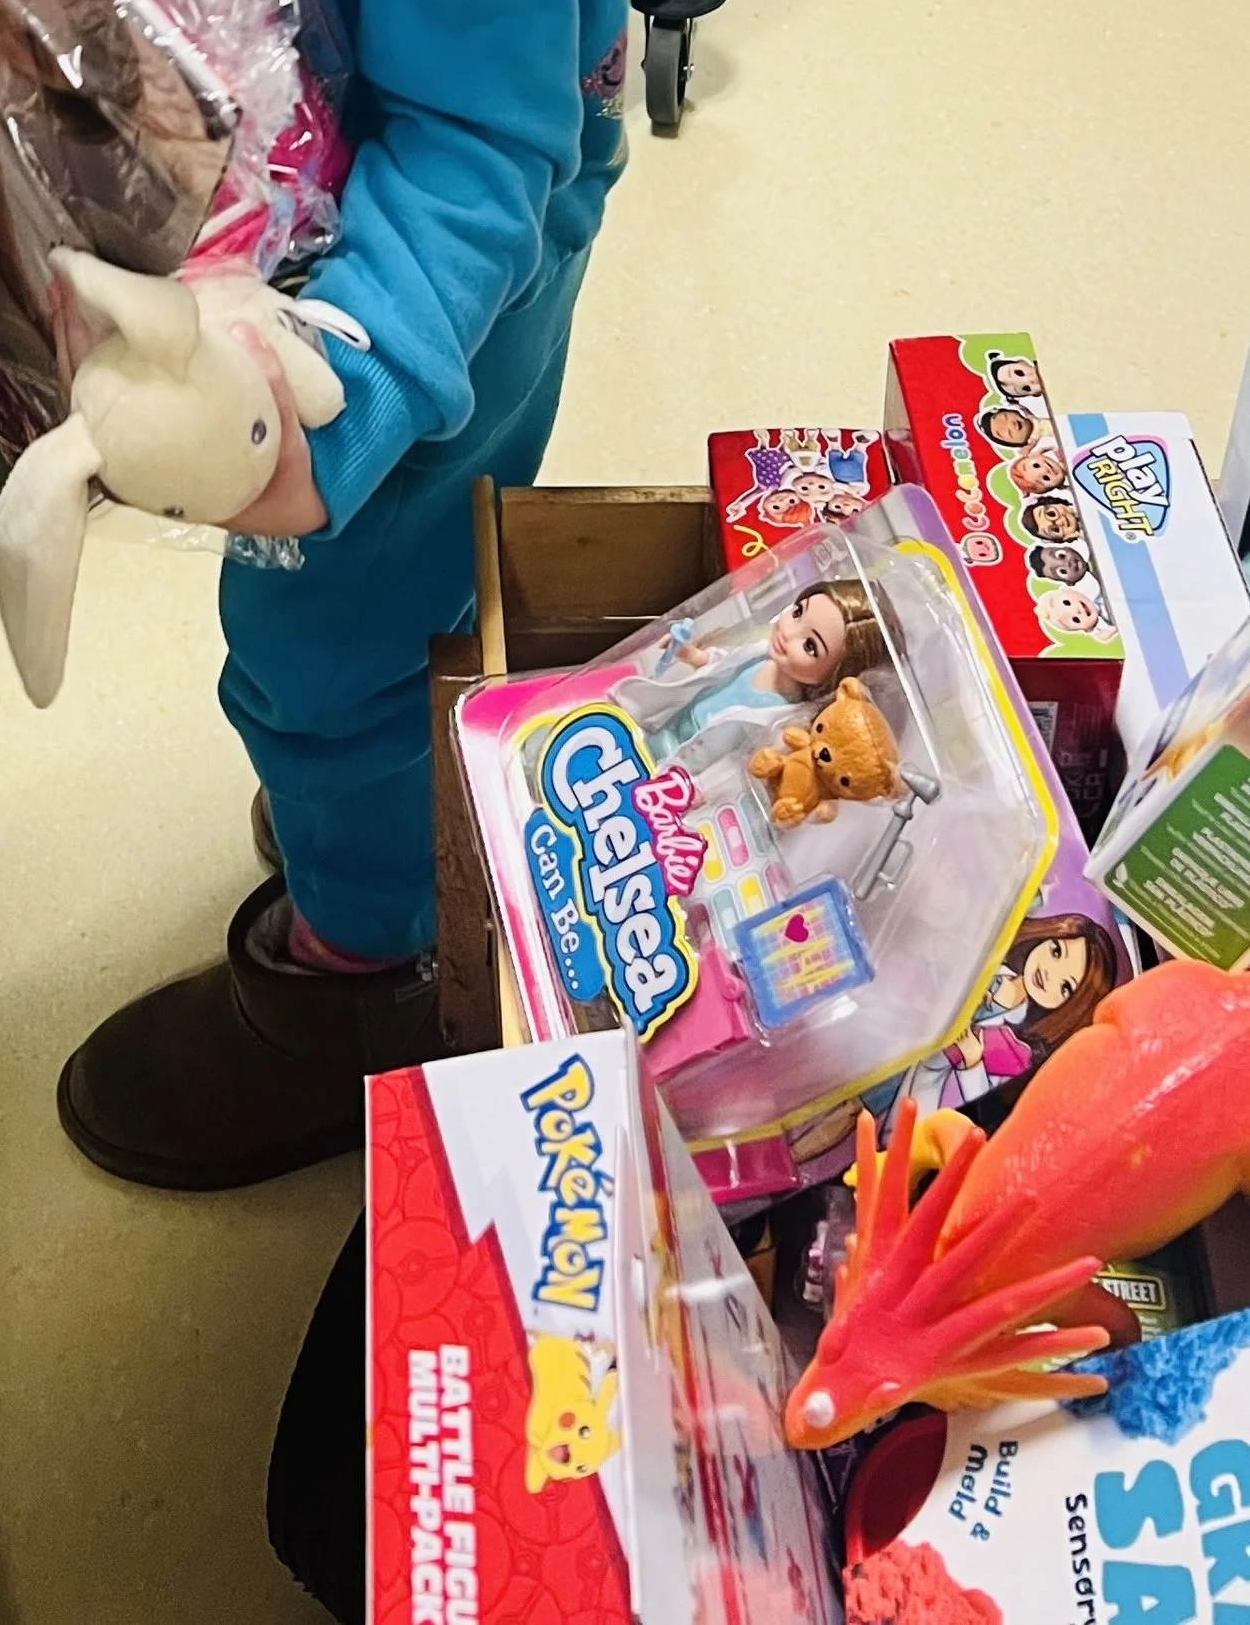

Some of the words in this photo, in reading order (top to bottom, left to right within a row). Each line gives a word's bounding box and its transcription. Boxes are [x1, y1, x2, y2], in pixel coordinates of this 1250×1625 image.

[1088, 460, 1155, 537] RIGHT
[530, 824, 565, 901] Can
[552, 726, 678, 1014] Chelsea
[635, 769, 704, 895] Barbie
[407, 1349, 444, 1625] MULTI-PACK
[440, 1343, 475, 1515] BATTLE
[983, 1440, 1019, 1517] Build
[969, 1522, 991, 1542] &
[1065, 1493, 1097, 1625] Sensor
